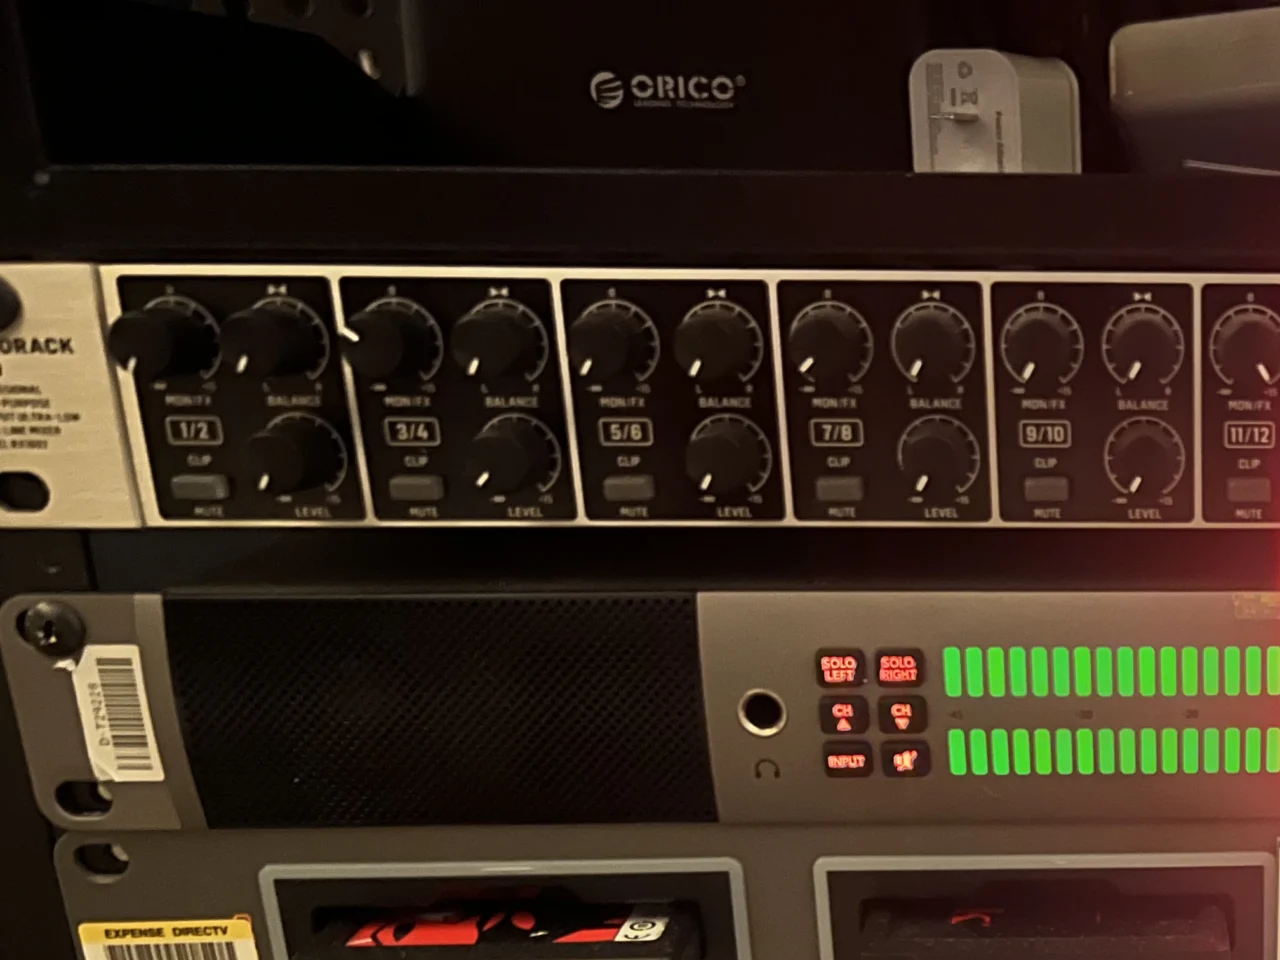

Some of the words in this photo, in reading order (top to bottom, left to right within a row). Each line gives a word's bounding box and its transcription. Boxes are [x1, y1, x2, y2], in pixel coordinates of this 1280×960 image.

[630, 74, 734, 100] ORICO
[267, 394, 322, 407] BALANCE
[485, 396, 539, 408] BALANCE
[698, 396, 751, 408] BALANCE
[910, 398, 962, 409] BALANCE
[1118, 400, 1168, 410] BALANCE
[180, 424, 209, 438] 1/2
[396, 424, 428, 439] 3/4
[610, 424, 642, 439] 5/6
[822, 425, 852, 440] 7/8
[1026, 426, 1064, 442] 9/10
[1230, 428, 1270, 443] 11/12
[295, 506, 331, 518] LEVEL
[508, 507, 543, 518] LEVEL
[717, 507, 752, 518] LEVEL
[924, 508, 958, 519] LEVEL
[1128, 509, 1162, 520] LEVEL
[821, 656, 857, 670] SOLO
[880, 656, 915, 669] SOLO
[824, 669, 855, 683] LEFT
[880, 668, 918, 681] RIGHT
[832, 704, 853, 717] CH
[891, 704, 912, 717] CH
[828, 755, 866, 768] INPUT
[104, 928, 165, 938] EXPENSE
[172, 926, 228, 936] DIRECTV
